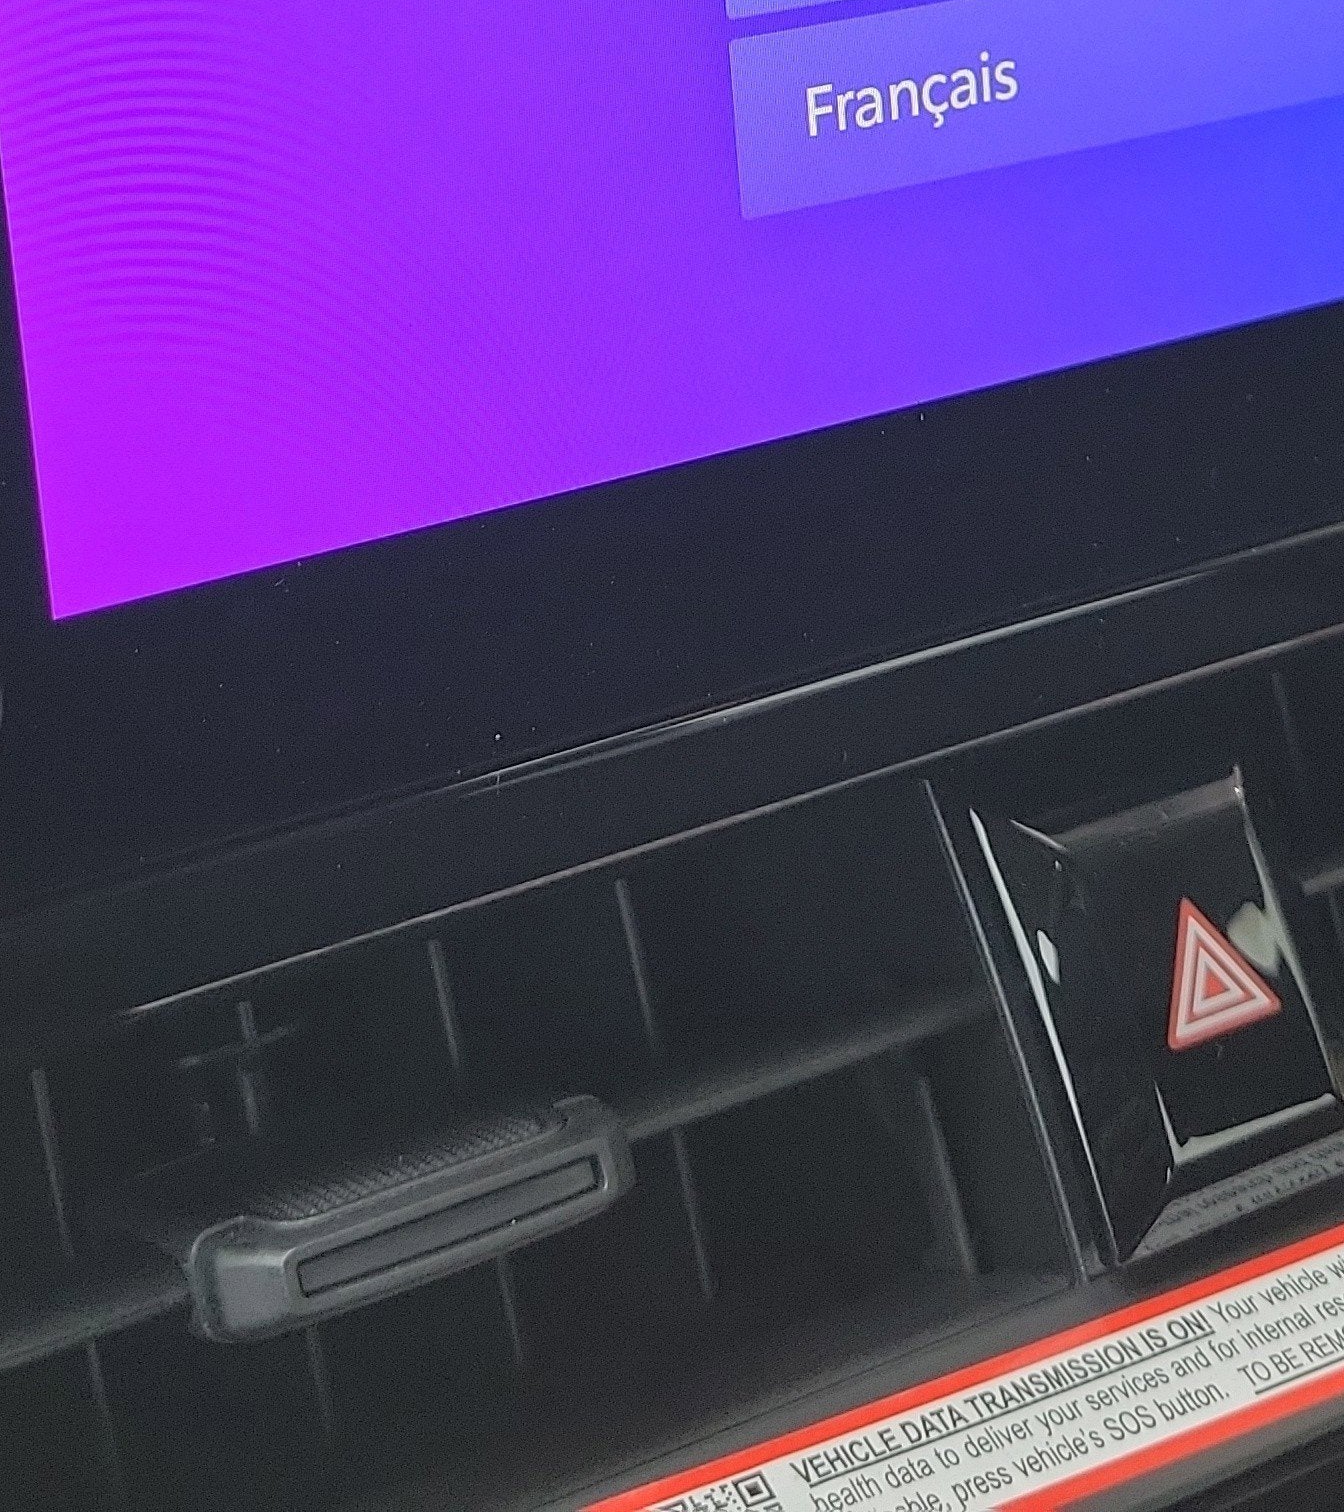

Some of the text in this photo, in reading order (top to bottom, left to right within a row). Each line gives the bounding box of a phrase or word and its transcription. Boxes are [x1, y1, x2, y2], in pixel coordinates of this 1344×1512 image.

[806, 51, 1020, 138] Français
[789, 1426, 902, 1485] VEHICLE
[899, 1403, 968, 1444] DATA
[964, 1336, 1144, 1421] TRANSMISSION
[1138, 1326, 1168, 1354] IS
[1166, 1308, 1215, 1341] ON!
[1207, 1294, 1260, 1324] Your
[1260, 1265, 1329, 1306] vehicle
[809, 1472, 883, 1512] health
[882, 1457, 936, 1490] data
[933, 1446, 962, 1470] to
[962, 1415, 1035, 1458] deliver
[1034, 1398, 1084, 1436] your
[1083, 1364, 1171, 1412] services
[1169, 1345, 1213, 1377] and
[1207, 1332, 1242, 1362] for
[1239, 1306, 1317, 1350] internal
[950, 1462, 1014, 1508] press
[1011, 1428, 1106, 1480] vehicle's
[1102, 1403, 1157, 1441] SOS
[1155, 1377, 1231, 1422] button.
[1236, 1360, 1273, 1386] TO
[1267, 1346, 1305, 1375] BE
